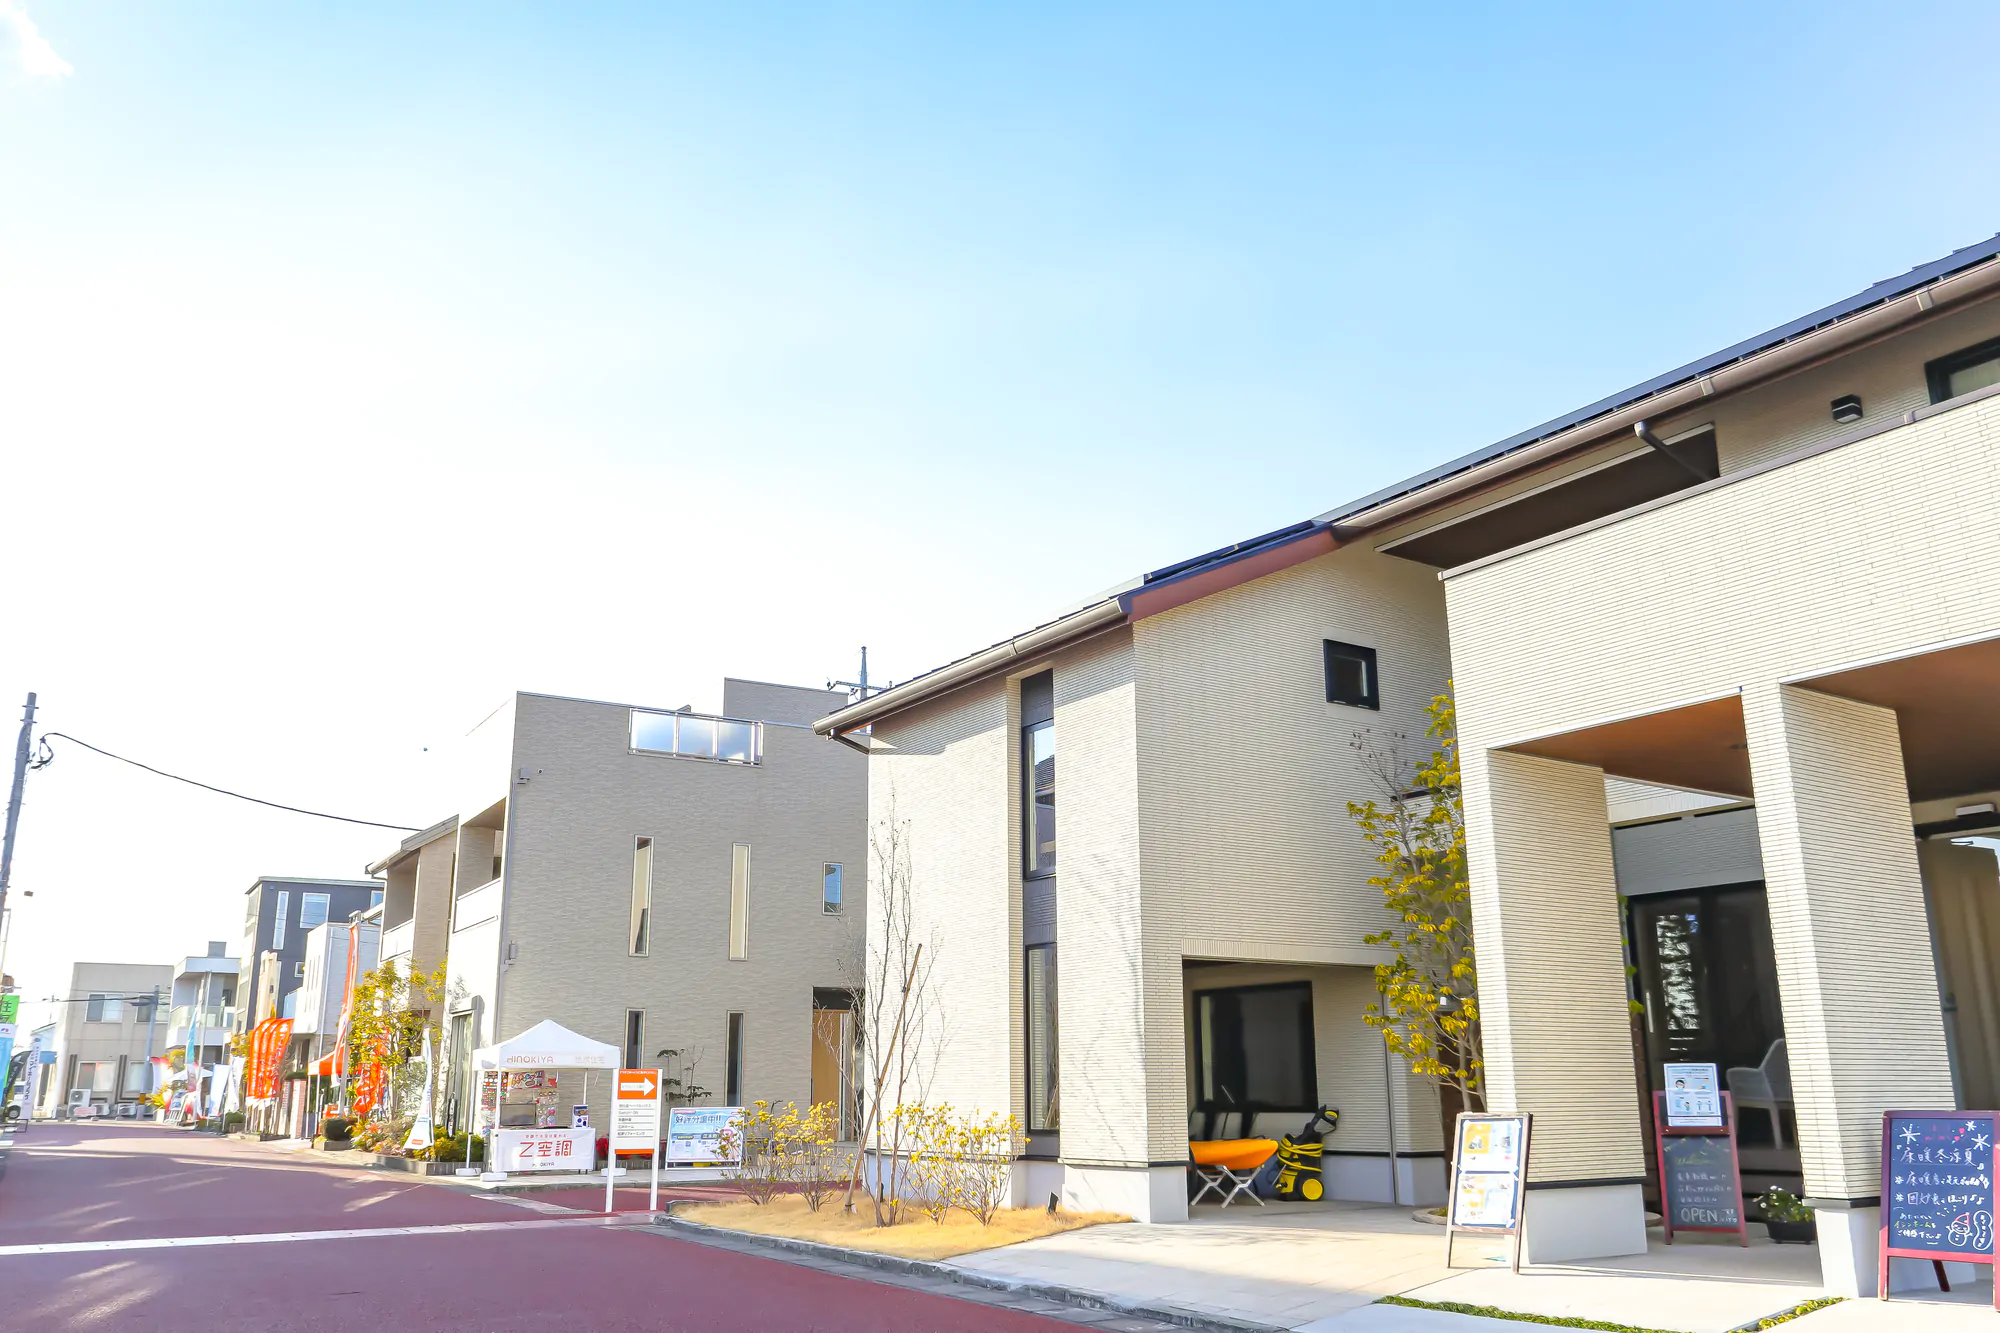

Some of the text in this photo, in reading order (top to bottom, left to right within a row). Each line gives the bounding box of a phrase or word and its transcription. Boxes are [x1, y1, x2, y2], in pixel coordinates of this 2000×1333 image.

[506, 1055, 554, 1064] HINOKIYA
[518, 1140, 572, 1158] Z空調
[1681, 1207, 1718, 1223] OPEN
